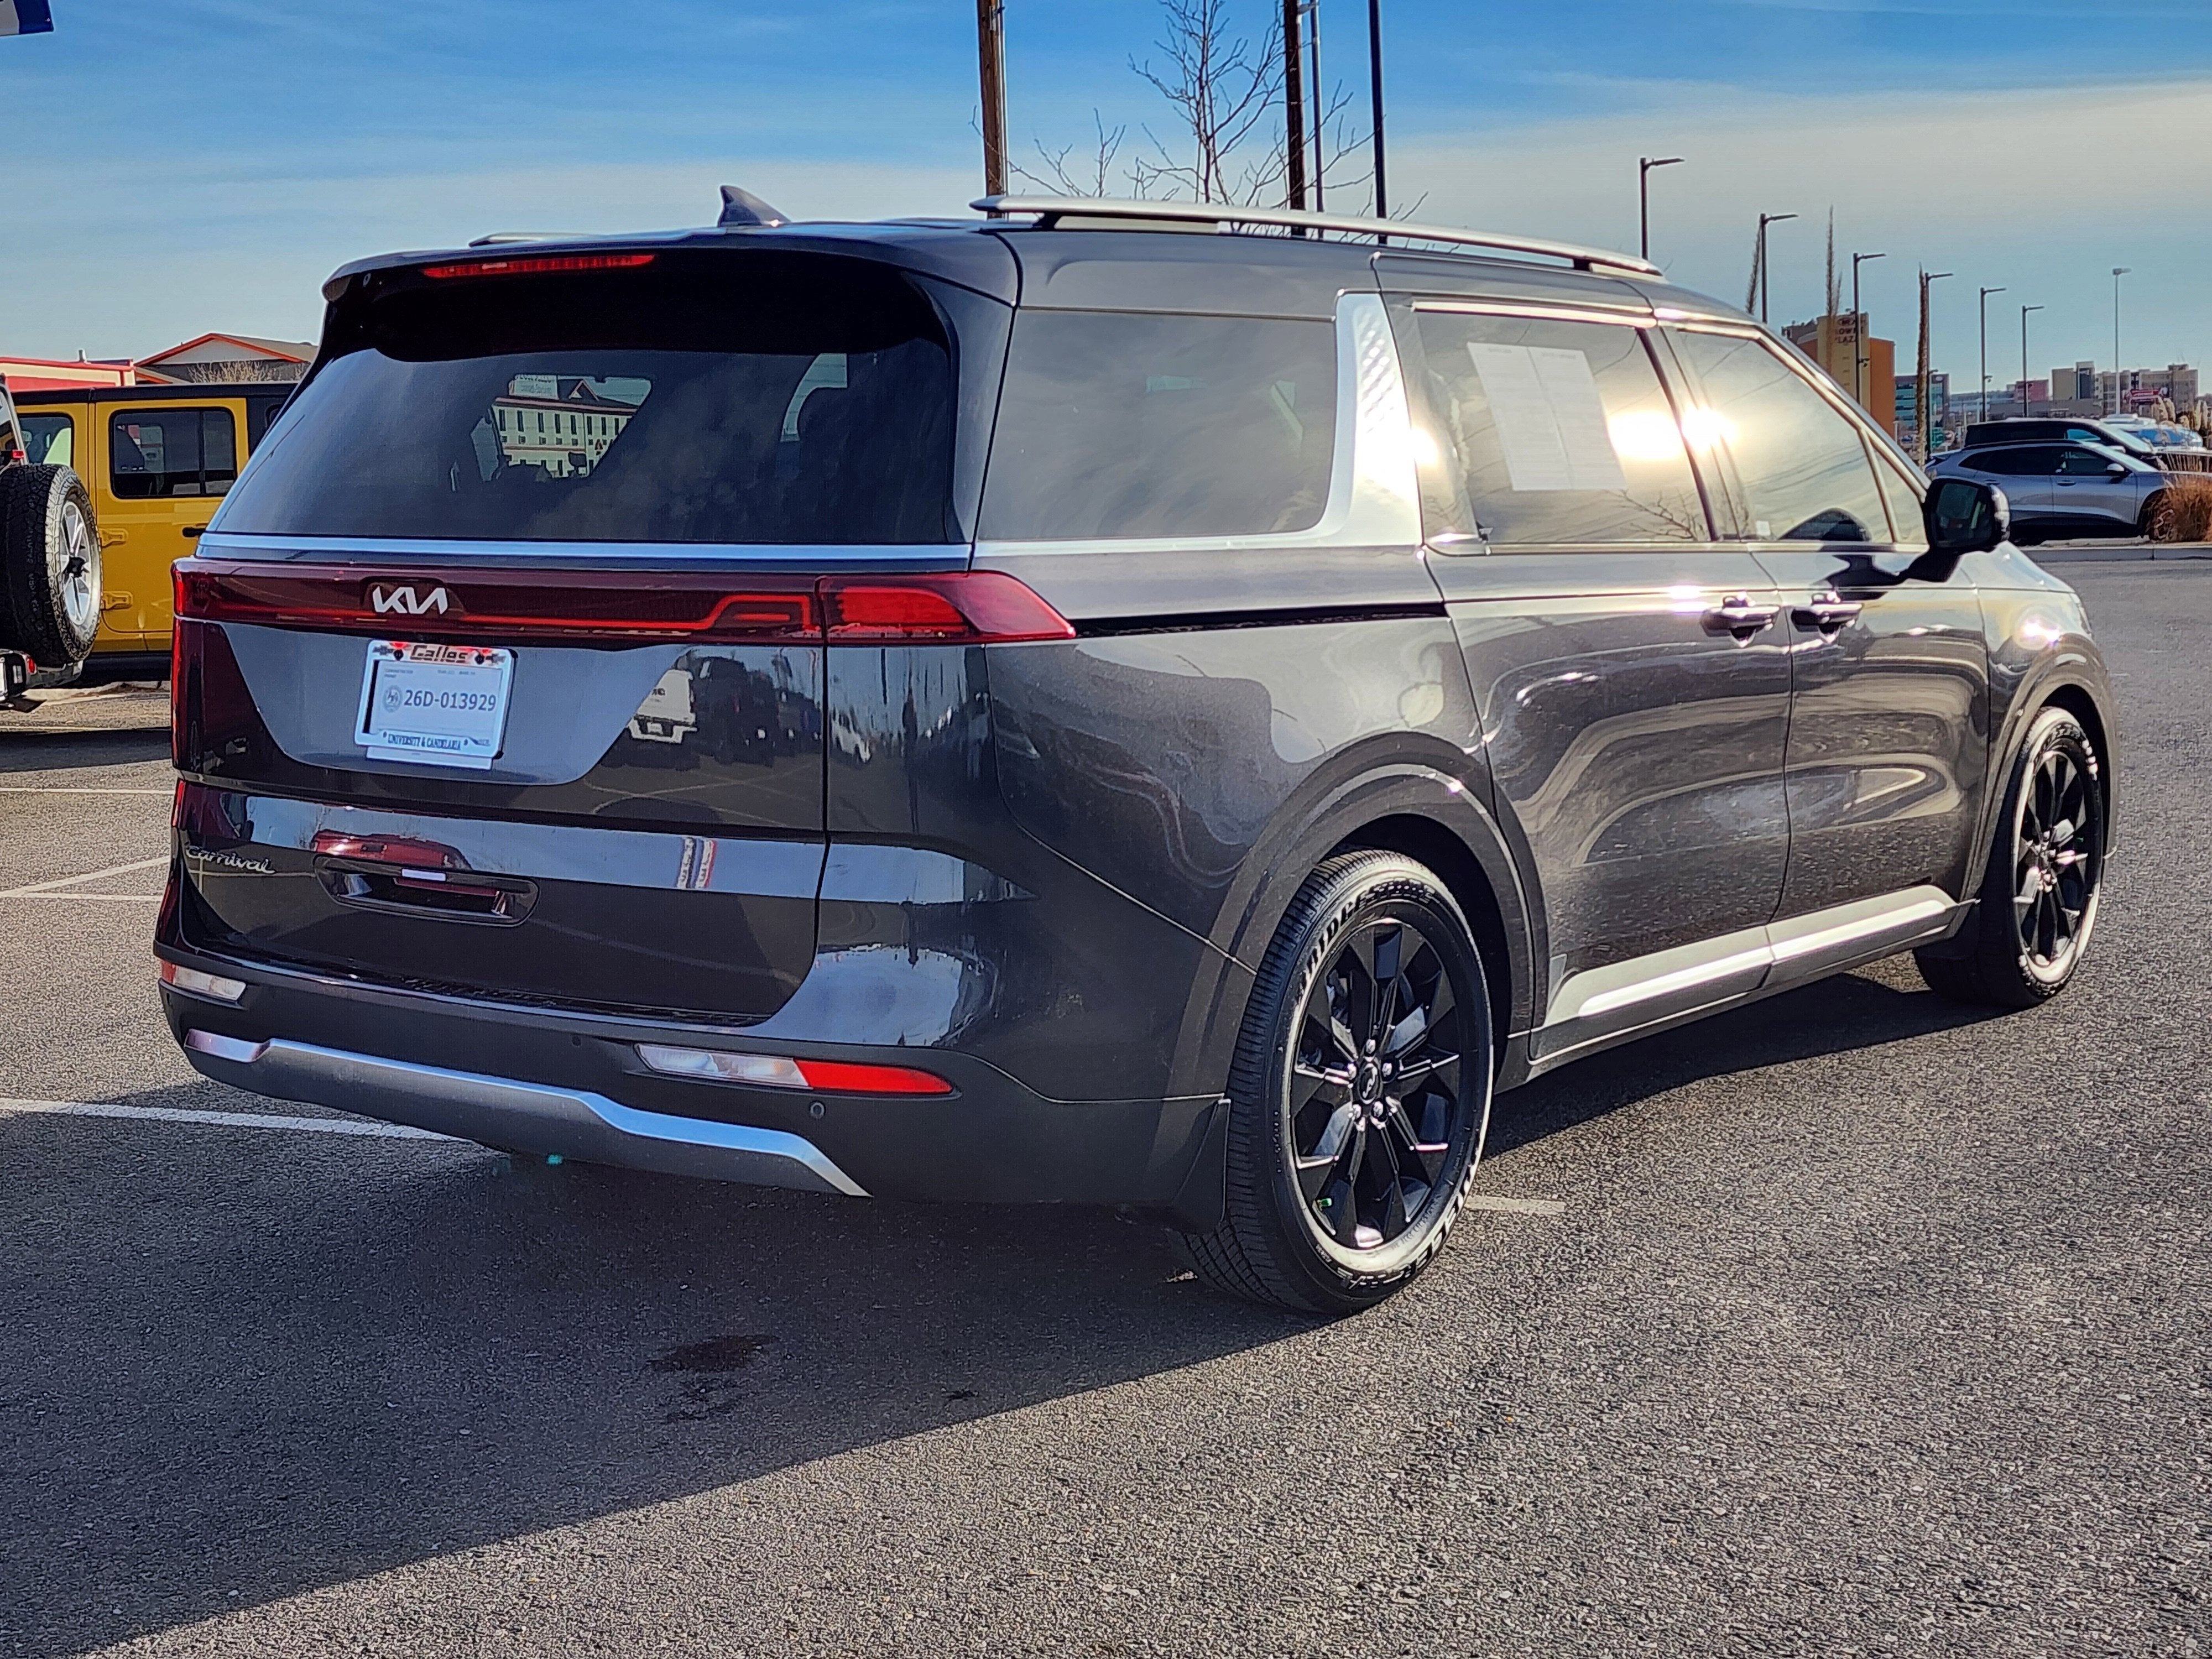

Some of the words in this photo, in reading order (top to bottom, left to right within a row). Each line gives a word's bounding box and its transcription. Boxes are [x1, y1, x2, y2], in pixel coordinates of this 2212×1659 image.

[372, 586, 448, 615] KIA
[404, 689, 497, 711] 26D-013929
[186, 846, 275, 874] Carnival
